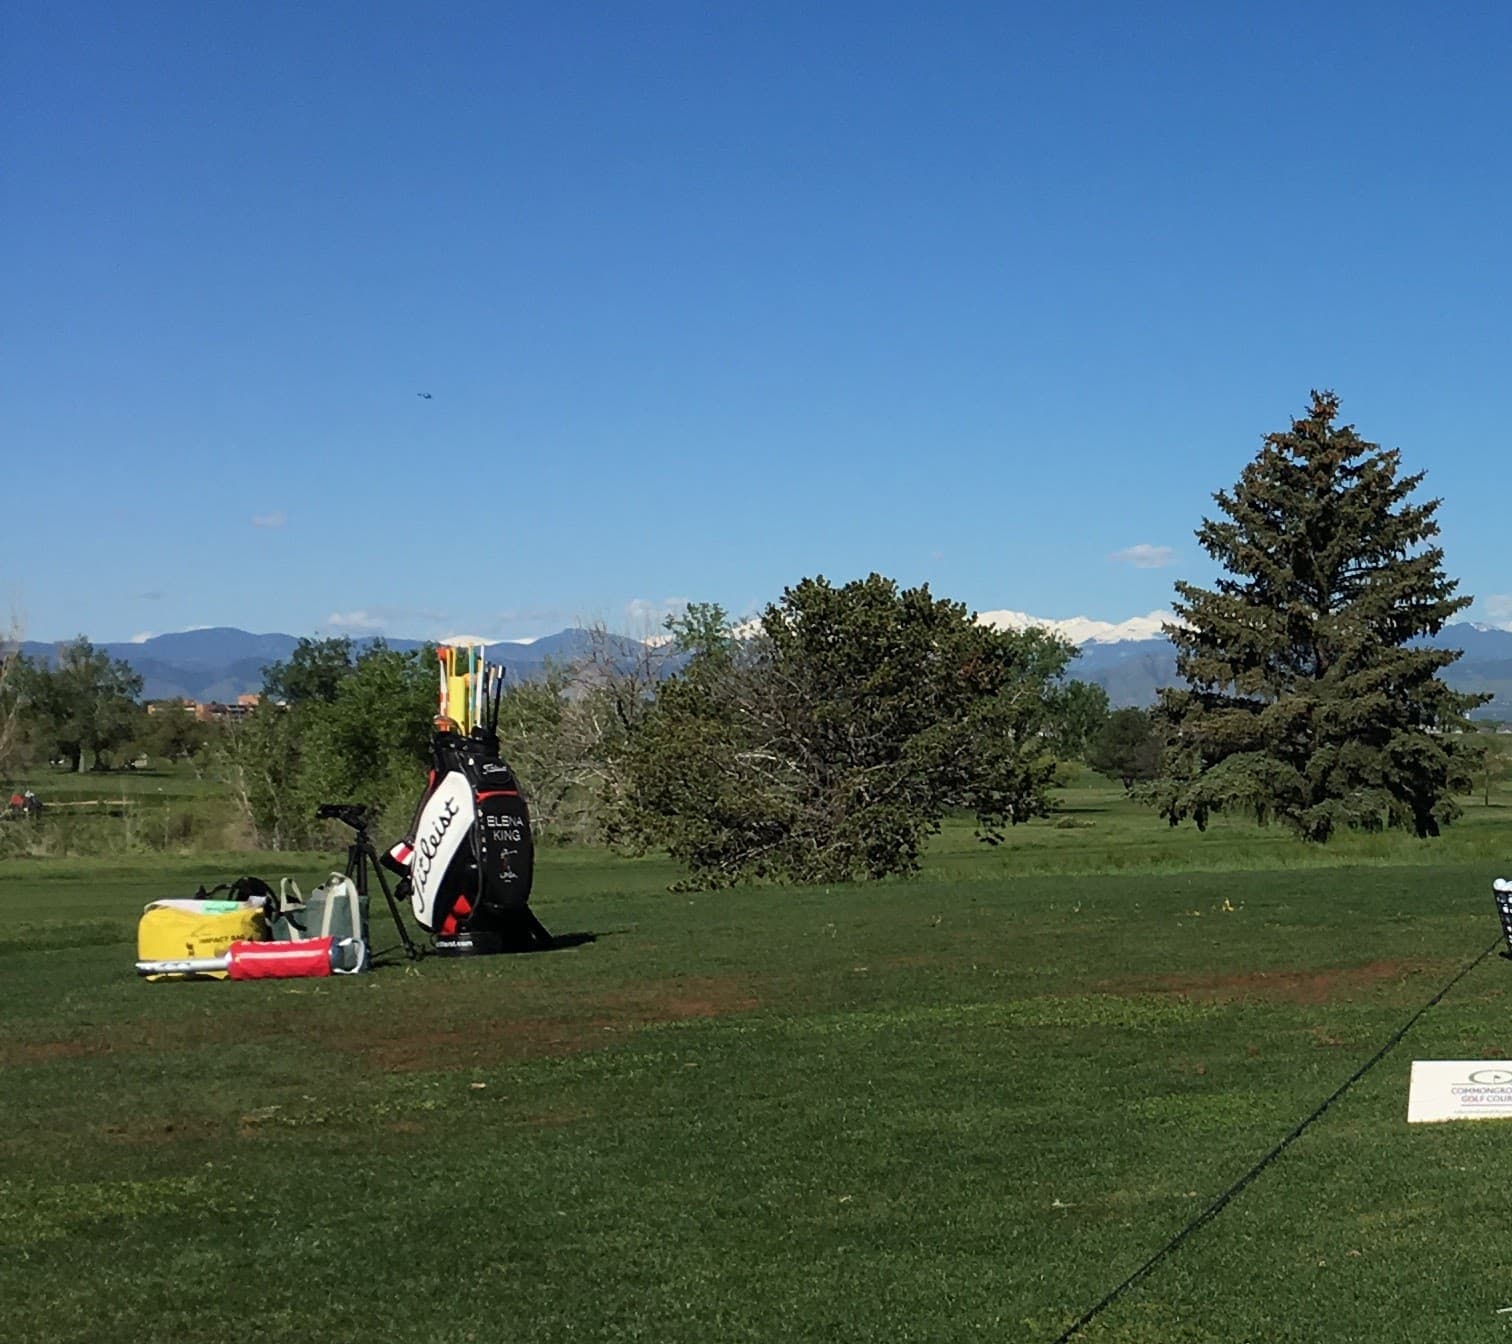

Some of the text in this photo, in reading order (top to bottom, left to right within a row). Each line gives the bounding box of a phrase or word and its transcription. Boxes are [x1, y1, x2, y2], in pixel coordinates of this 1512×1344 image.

[486, 815, 524, 827] ELENA
[493, 829, 521, 842] KING
[411, 797, 459, 913] Titleist
